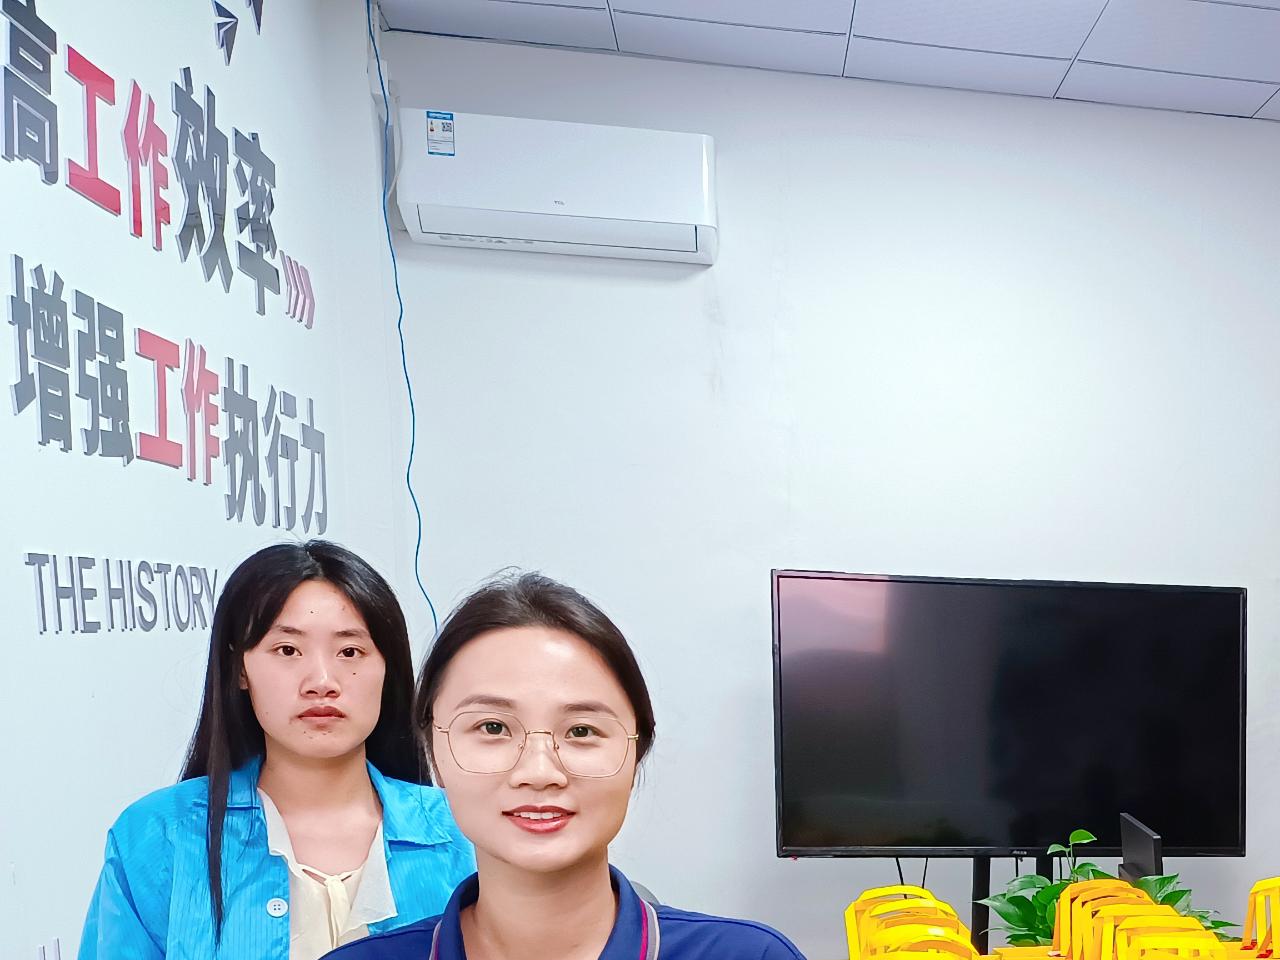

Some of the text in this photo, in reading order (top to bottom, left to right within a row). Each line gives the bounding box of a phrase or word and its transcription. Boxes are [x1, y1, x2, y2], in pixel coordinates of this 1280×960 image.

[11, 254, 328, 535] 增强工作执行力
[25, 553, 218, 635] THE HISTORY
